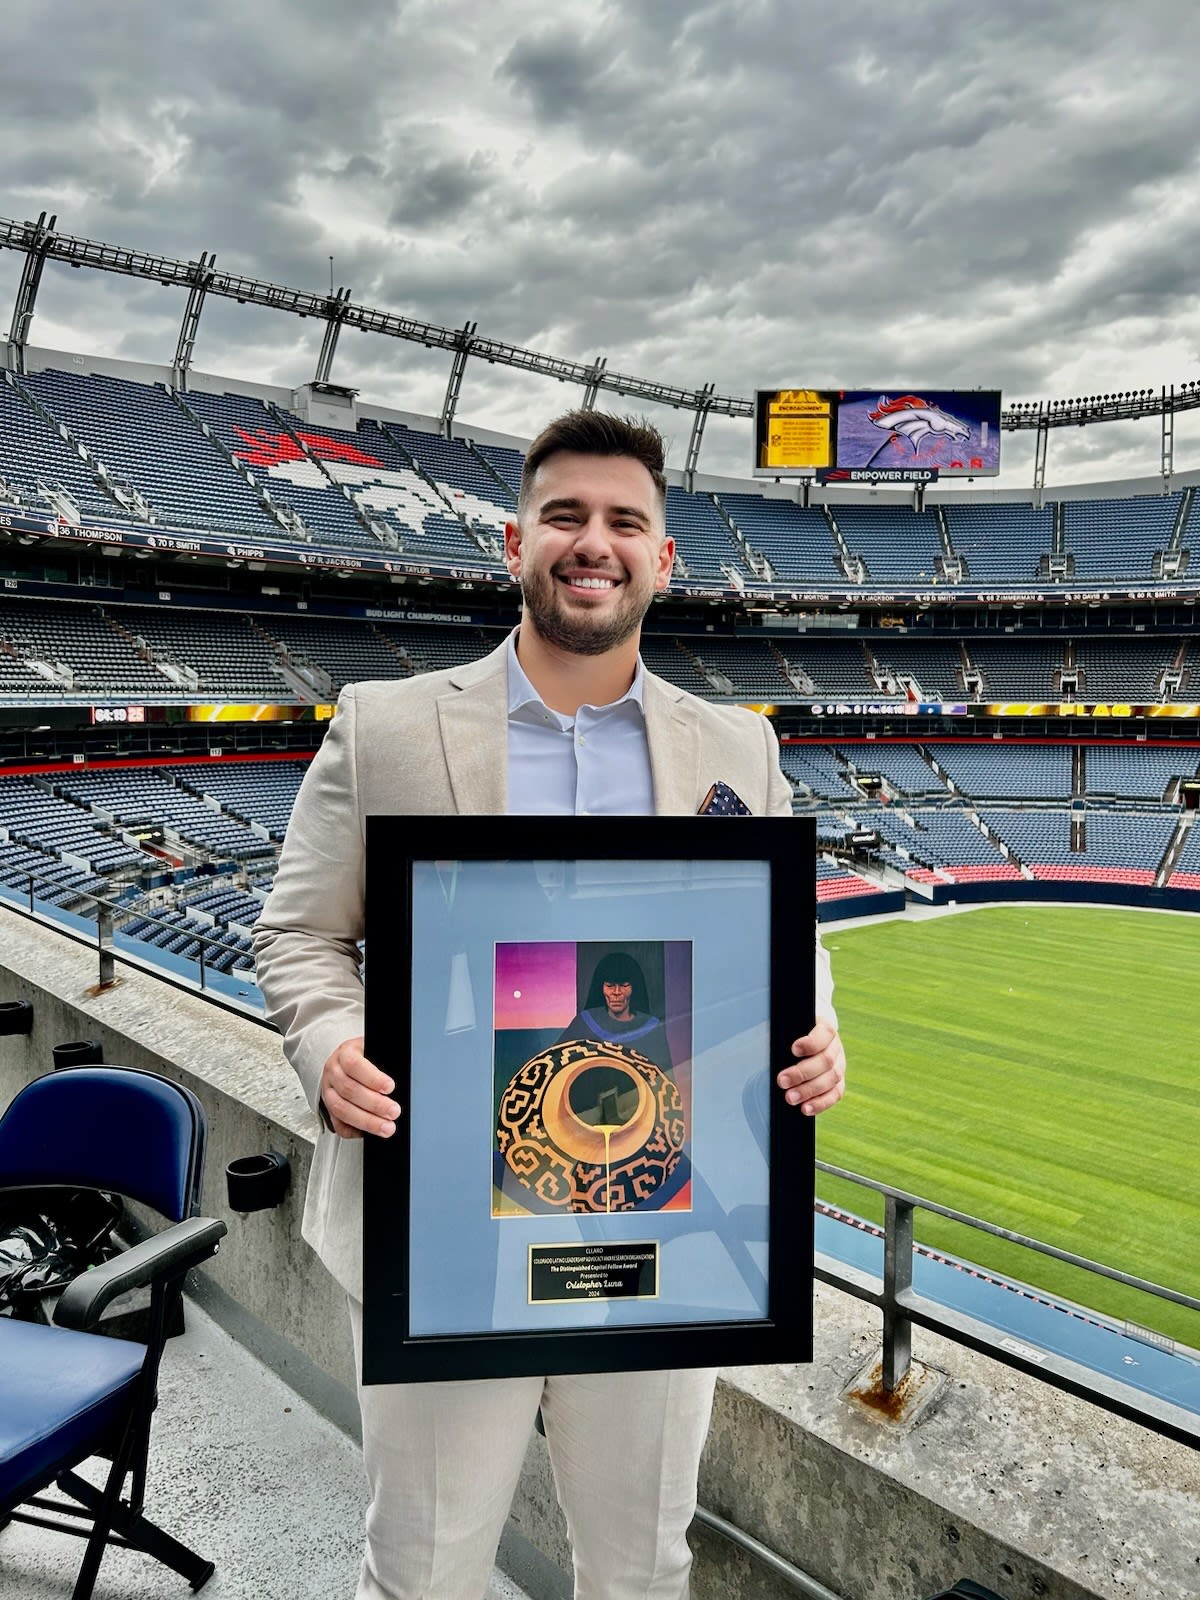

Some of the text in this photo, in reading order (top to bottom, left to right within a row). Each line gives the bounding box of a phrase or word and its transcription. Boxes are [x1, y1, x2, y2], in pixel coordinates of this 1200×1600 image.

[850, 471, 932, 480] EMPOWER FIELD
[59, 526, 123, 542] 36 THOMPSON
[158, 539, 200, 551] 70 P. SMITH
[237, 549, 264, 558] PHIPPS
[325, 558, 362, 567] JACKSON
[404, 565, 430, 575] TAYLOR
[365, 609, 382, 617] BUD
[383, 610, 405, 619] LIGHT
[407, 612, 452, 621] CHAMPIONS
[1059, 703, 1132, 717] FLAG
[559, 1264, 590, 1273] Distinguished
[603, 1279, 623, 1288] Luna
